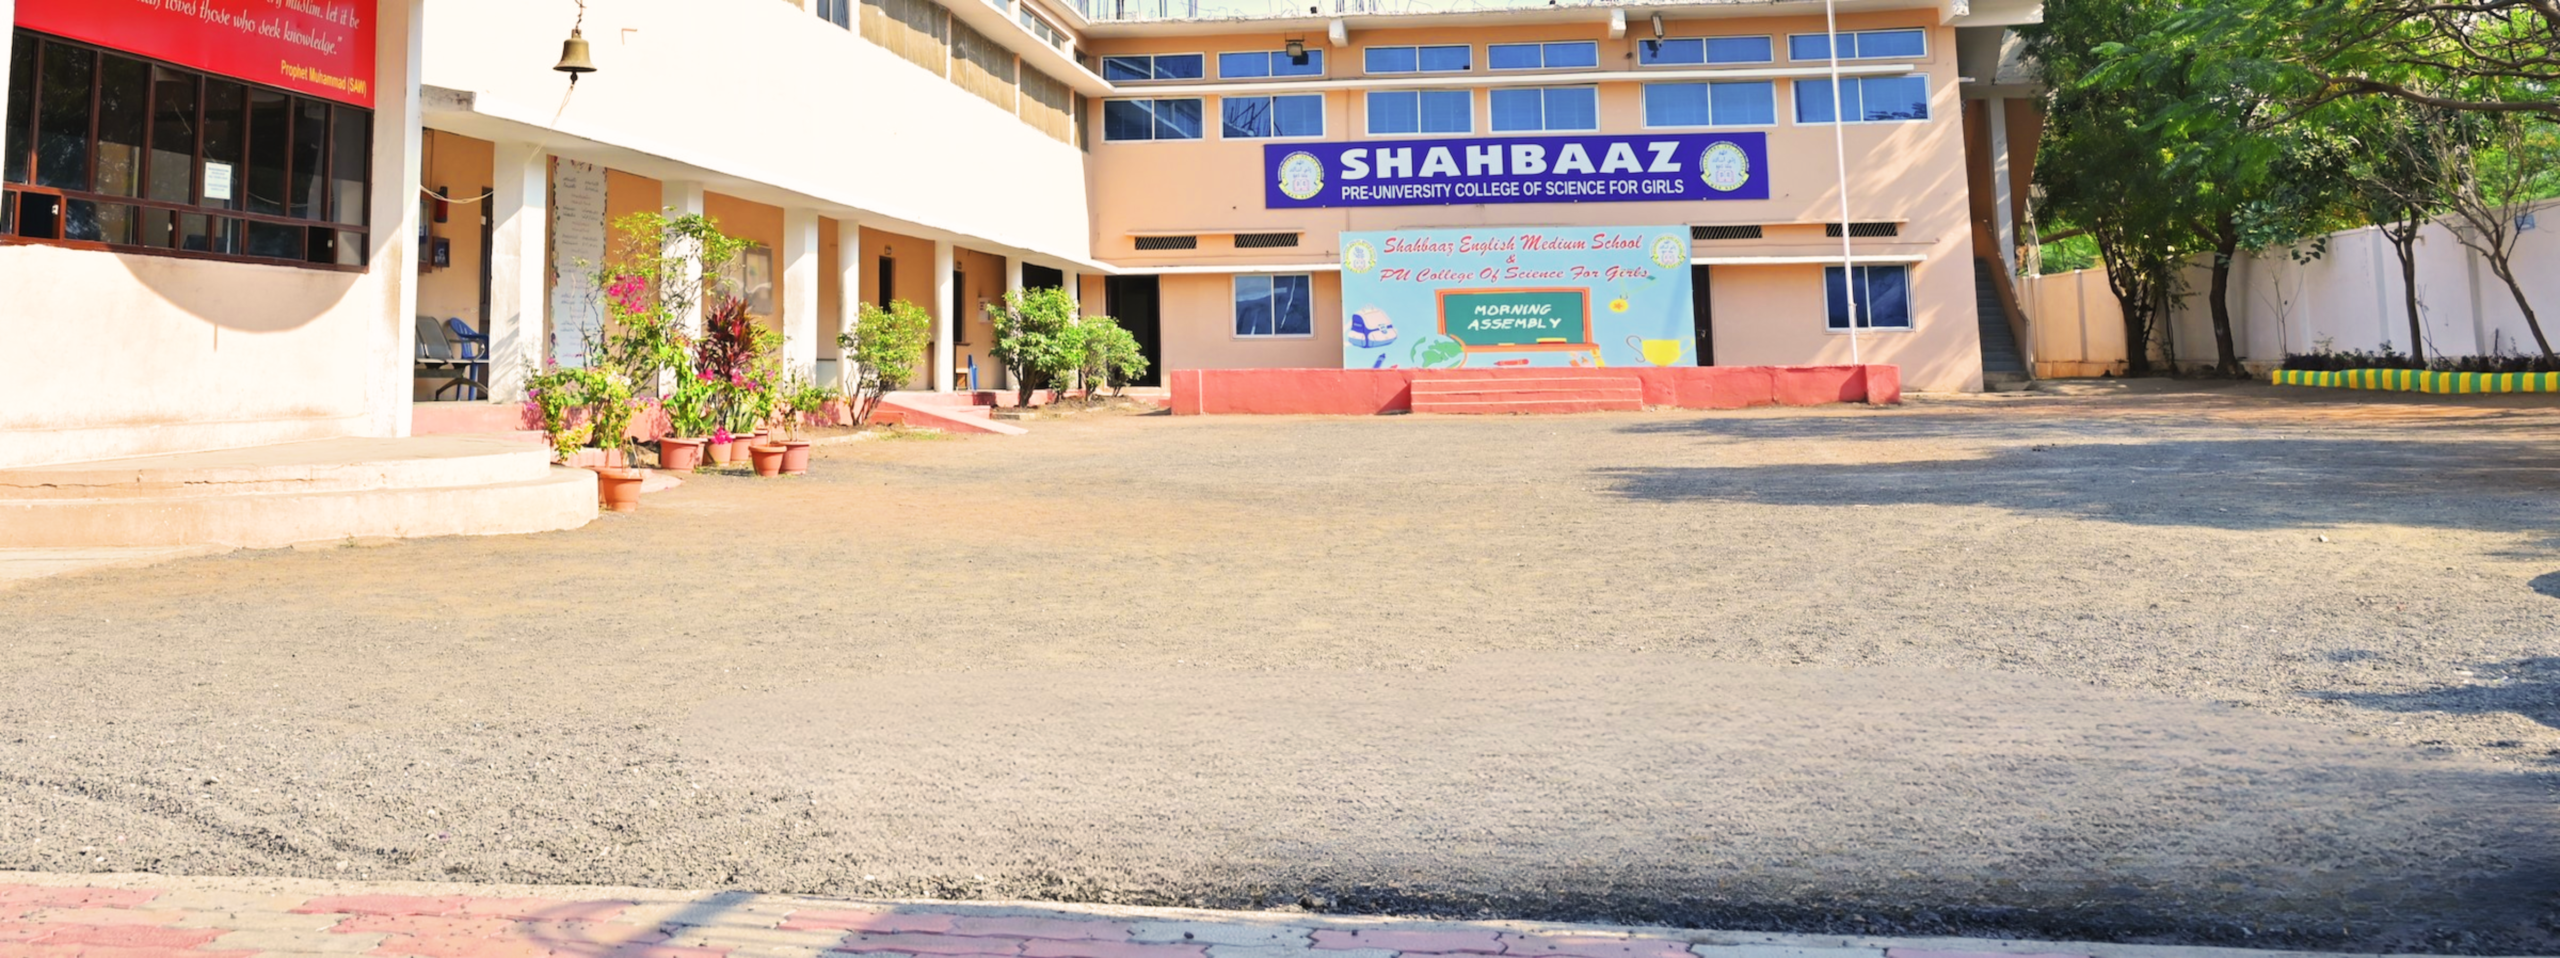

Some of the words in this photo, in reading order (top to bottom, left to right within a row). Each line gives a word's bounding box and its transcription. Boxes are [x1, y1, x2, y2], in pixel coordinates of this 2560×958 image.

[199, 0, 231, 25] those
[233, 9, 256, 33] who
[258, 18, 281, 39] seek
[326, 1, 338, 24] let
[340, 7, 347, 26] it
[349, 8, 360, 29] be
[281, 60, 308, 81] Prophet
[309, 67, 346, 90] Muhammad
[347, 77, 367, 98] (SAW)
[1340, 141, 1682, 180] SHAHBAAZ
[1341, 183, 1452, 200] PRE-UNIVERSITY
[1454, 182, 1520, 197] COLLEGE
[1523, 181, 1542, 196] OF
[1545, 180, 1606, 195] SCIENCE
[1609, 180, 1639, 194] FOR
[1641, 179, 1684, 194] GIRLS
[1383, 236, 1454, 256] Shahbaaz
[1459, 235, 1516, 255] English
[1520, 234, 1587, 250] Medium
[1591, 233, 1643, 249] School
[1505, 253, 1516, 264] &
[1380, 268, 1411, 281] PU
[1415, 267, 1475, 284] College
[1479, 267, 1501, 283] Of
[1504, 266, 1564, 279] Science
[1569, 265, 1599, 280] For
[1604, 265, 1649, 282] Girls
[1474, 304, 1552, 316] MORNING
[1467, 318, 1562, 331] ASSEMBLY
